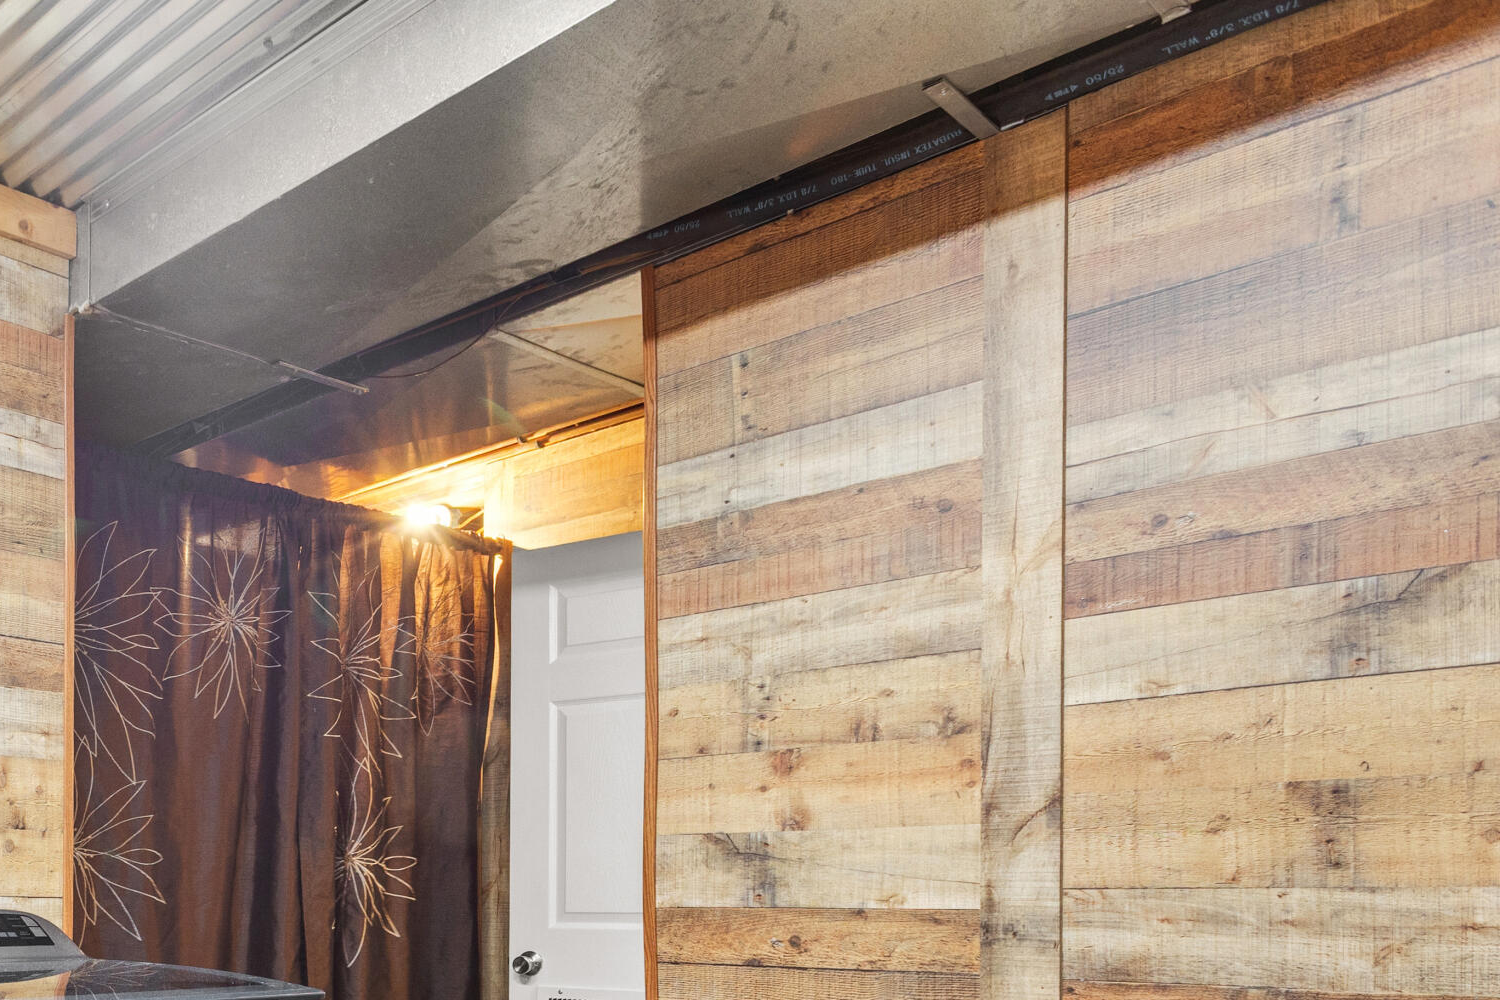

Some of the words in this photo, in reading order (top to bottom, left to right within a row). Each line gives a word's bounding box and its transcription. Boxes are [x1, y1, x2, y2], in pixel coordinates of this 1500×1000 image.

[1162, 36, 1199, 54] WALL
[1085, 64, 1124, 86] 25/50
[914, 128, 963, 154] RUBATEX
[727, 205, 751, 218] WALL
